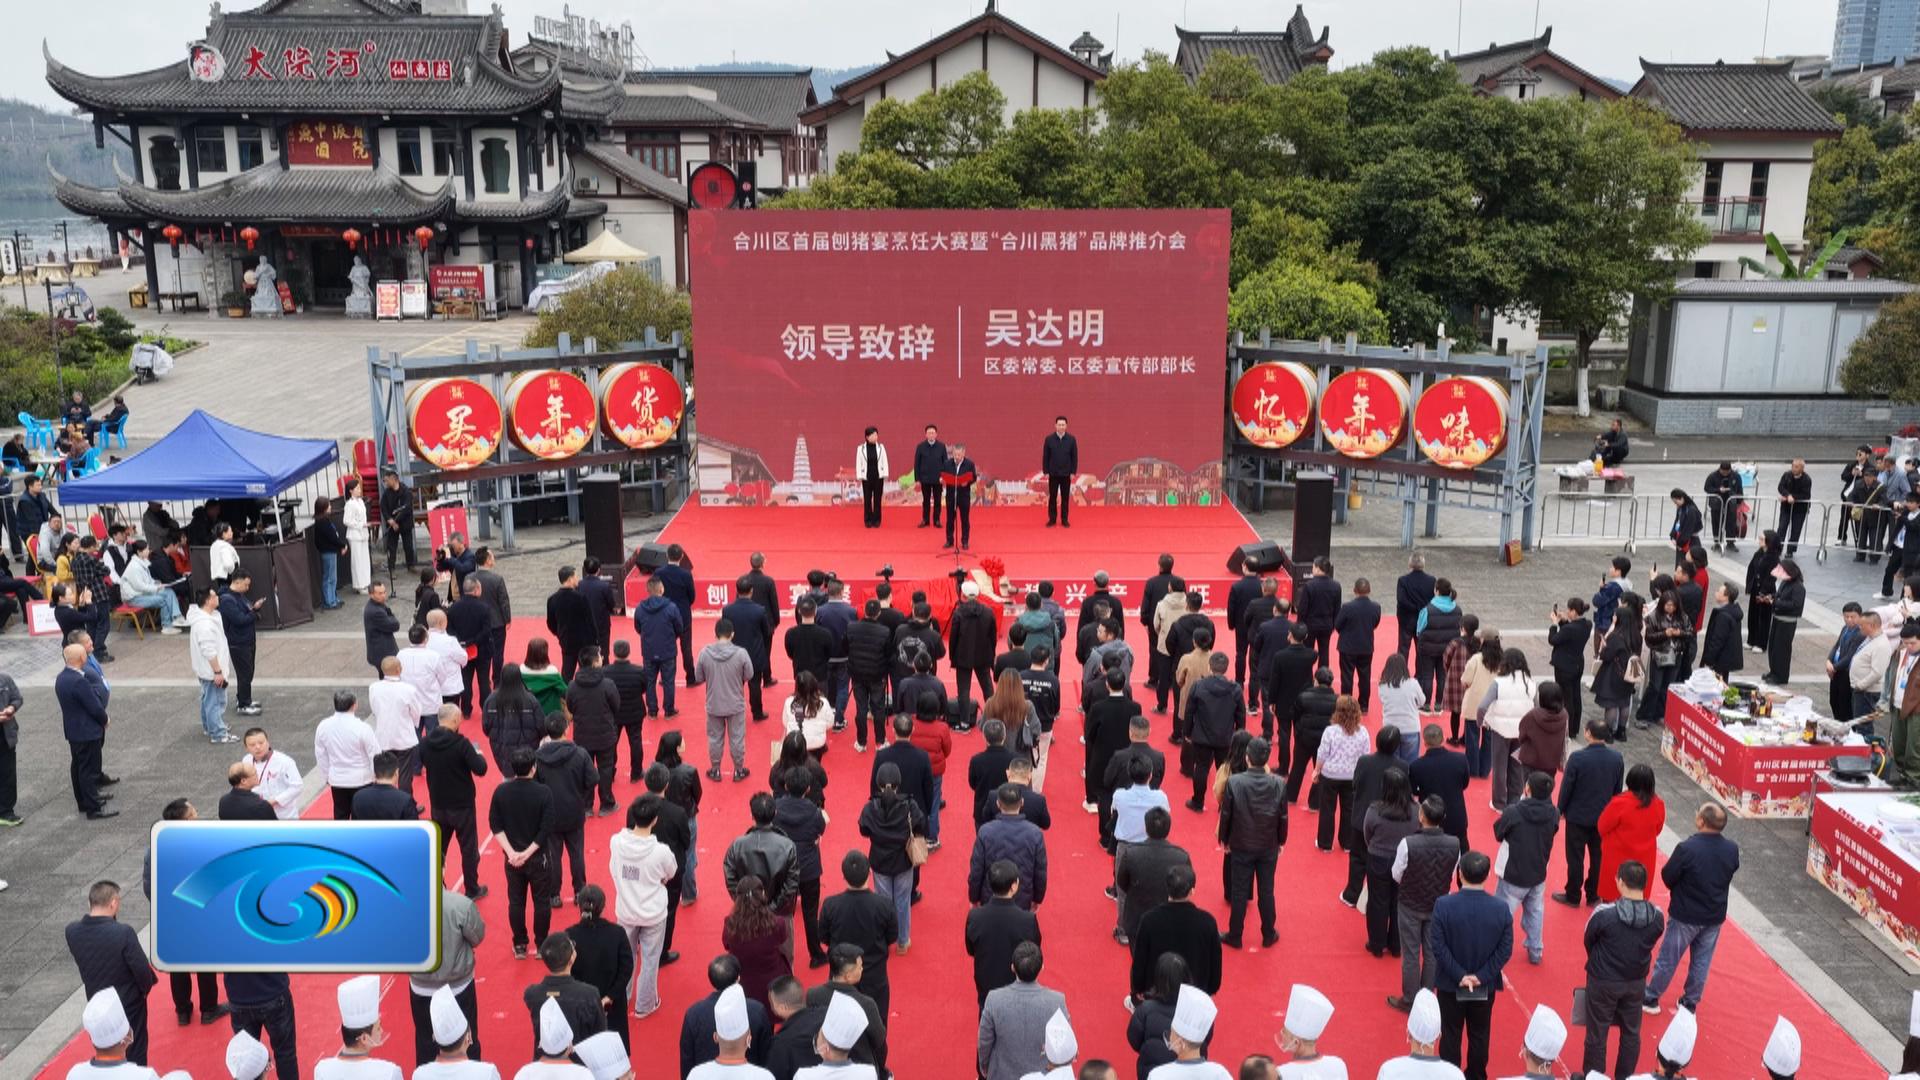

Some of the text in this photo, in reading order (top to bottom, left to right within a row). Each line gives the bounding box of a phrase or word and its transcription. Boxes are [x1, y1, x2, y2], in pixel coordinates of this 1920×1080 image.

[242, 45, 361, 80] 大院河
[733, 231, 1187, 251] 合川区首届刨猪宴烹饪大赛暨“合川黑猪”品牌推介会
[780, 323, 935, 361] 领导致辞
[985, 308, 1104, 347] 吴达明
[984, 355, 1196, 375] 区委常委、区委宣传部部长
[441, 387, 659, 445] 买 年 货
[1253, 387, 1474, 443] 忆 年 味
